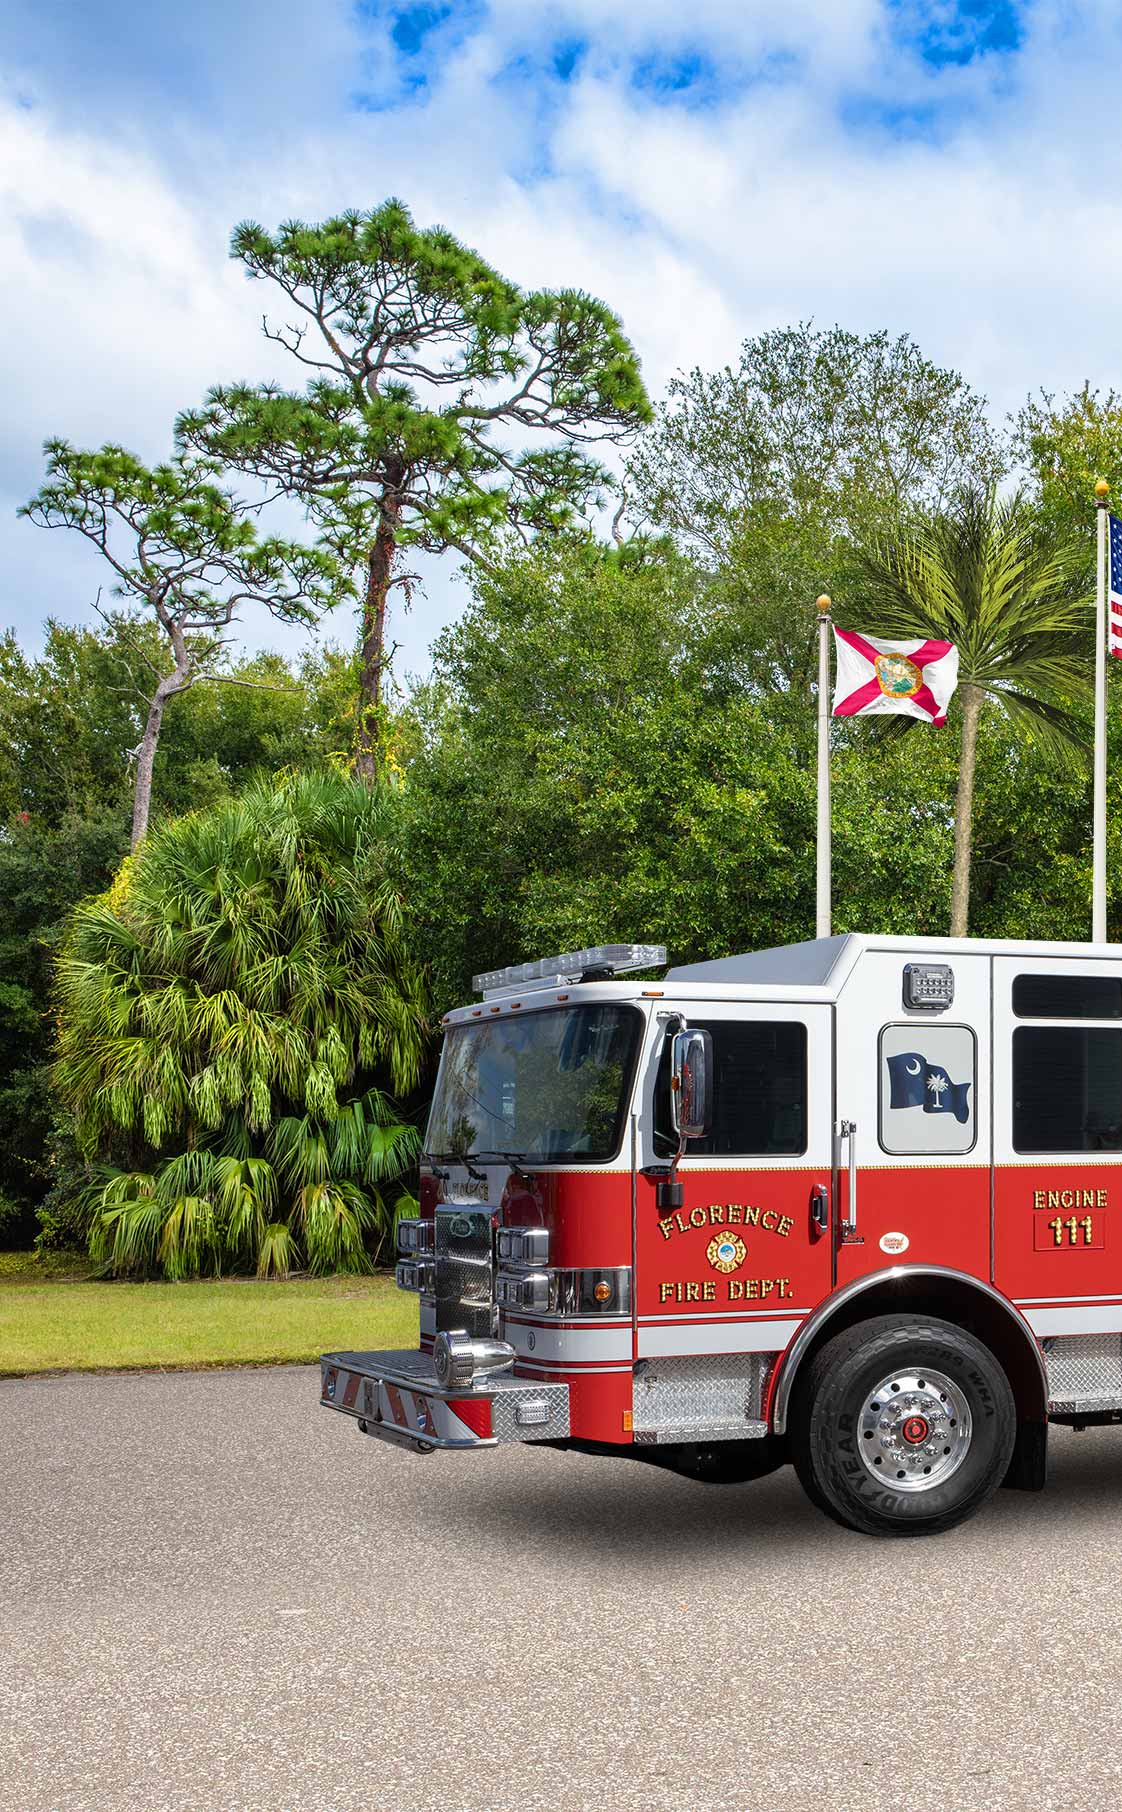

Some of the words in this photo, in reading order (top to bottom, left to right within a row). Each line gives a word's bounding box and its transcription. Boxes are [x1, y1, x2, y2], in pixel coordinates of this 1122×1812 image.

[1033, 1189, 1108, 1210] ENGINE
[658, 1204, 795, 1240] FLORENCE
[1048, 1216, 1092, 1246] 111
[659, 1281, 716, 1303] FIRE
[728, 1278, 794, 1301] DEPT.
